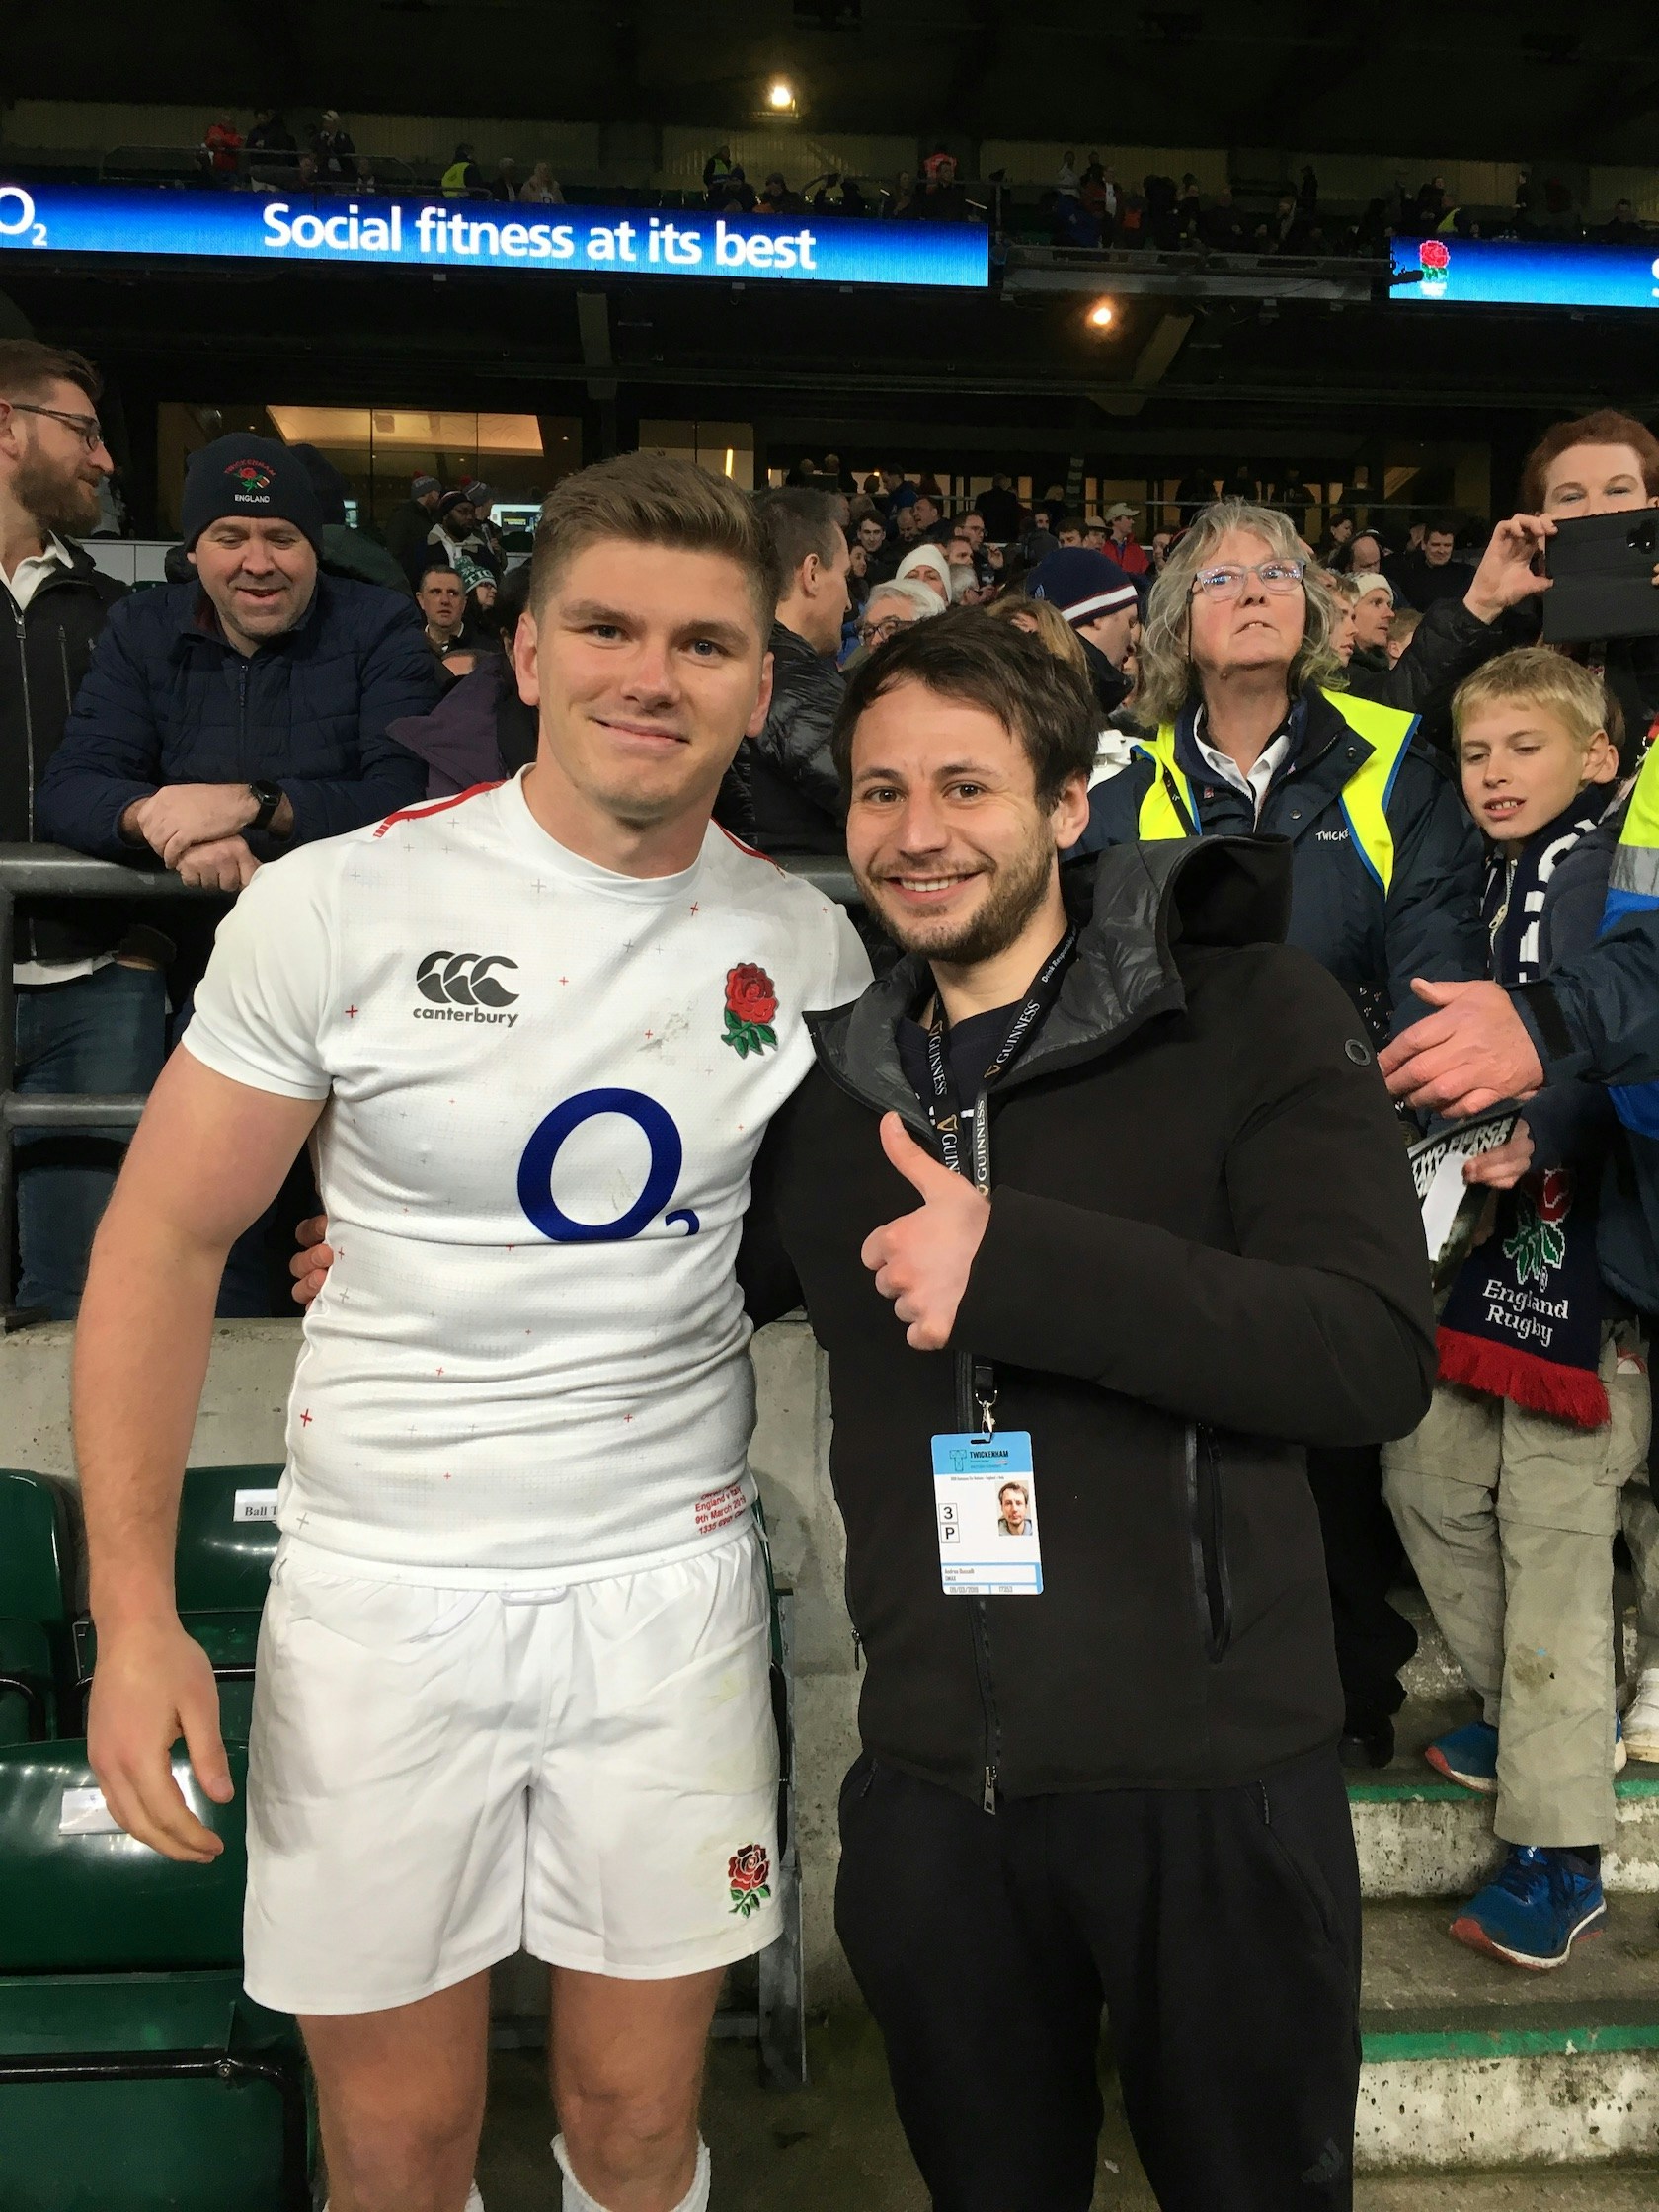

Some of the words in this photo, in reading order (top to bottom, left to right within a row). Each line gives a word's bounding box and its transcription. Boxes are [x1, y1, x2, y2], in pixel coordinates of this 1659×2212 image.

[263, 202, 401, 252] Social
[416, 206, 574, 258] fitness
[587, 220, 636, 263] at
[648, 217, 702, 265] its
[716, 220, 817, 270] best
[234, 494, 270, 504] ENGLAND
[413, 1007, 519, 1028] canterbury
[996, 999, 1040, 1064] GUINNESS
[928, 1036, 947, 1096] GUINNESS
[977, 1099, 988, 1182] GUINNESS
[942, 1134, 960, 1175] GUIN
[1482, 1279, 1568, 1320] England
[1485, 1304, 1554, 1348] Rugby
[970, 1450, 1009, 1459] TWICKENHAM
[245, 1506, 267, 1516] Ball
[695, 1494, 726, 1512] England
[710, 1504, 732, 1519] March
[943, 1506, 953, 1520] 3
[945, 1527, 955, 1540] P
